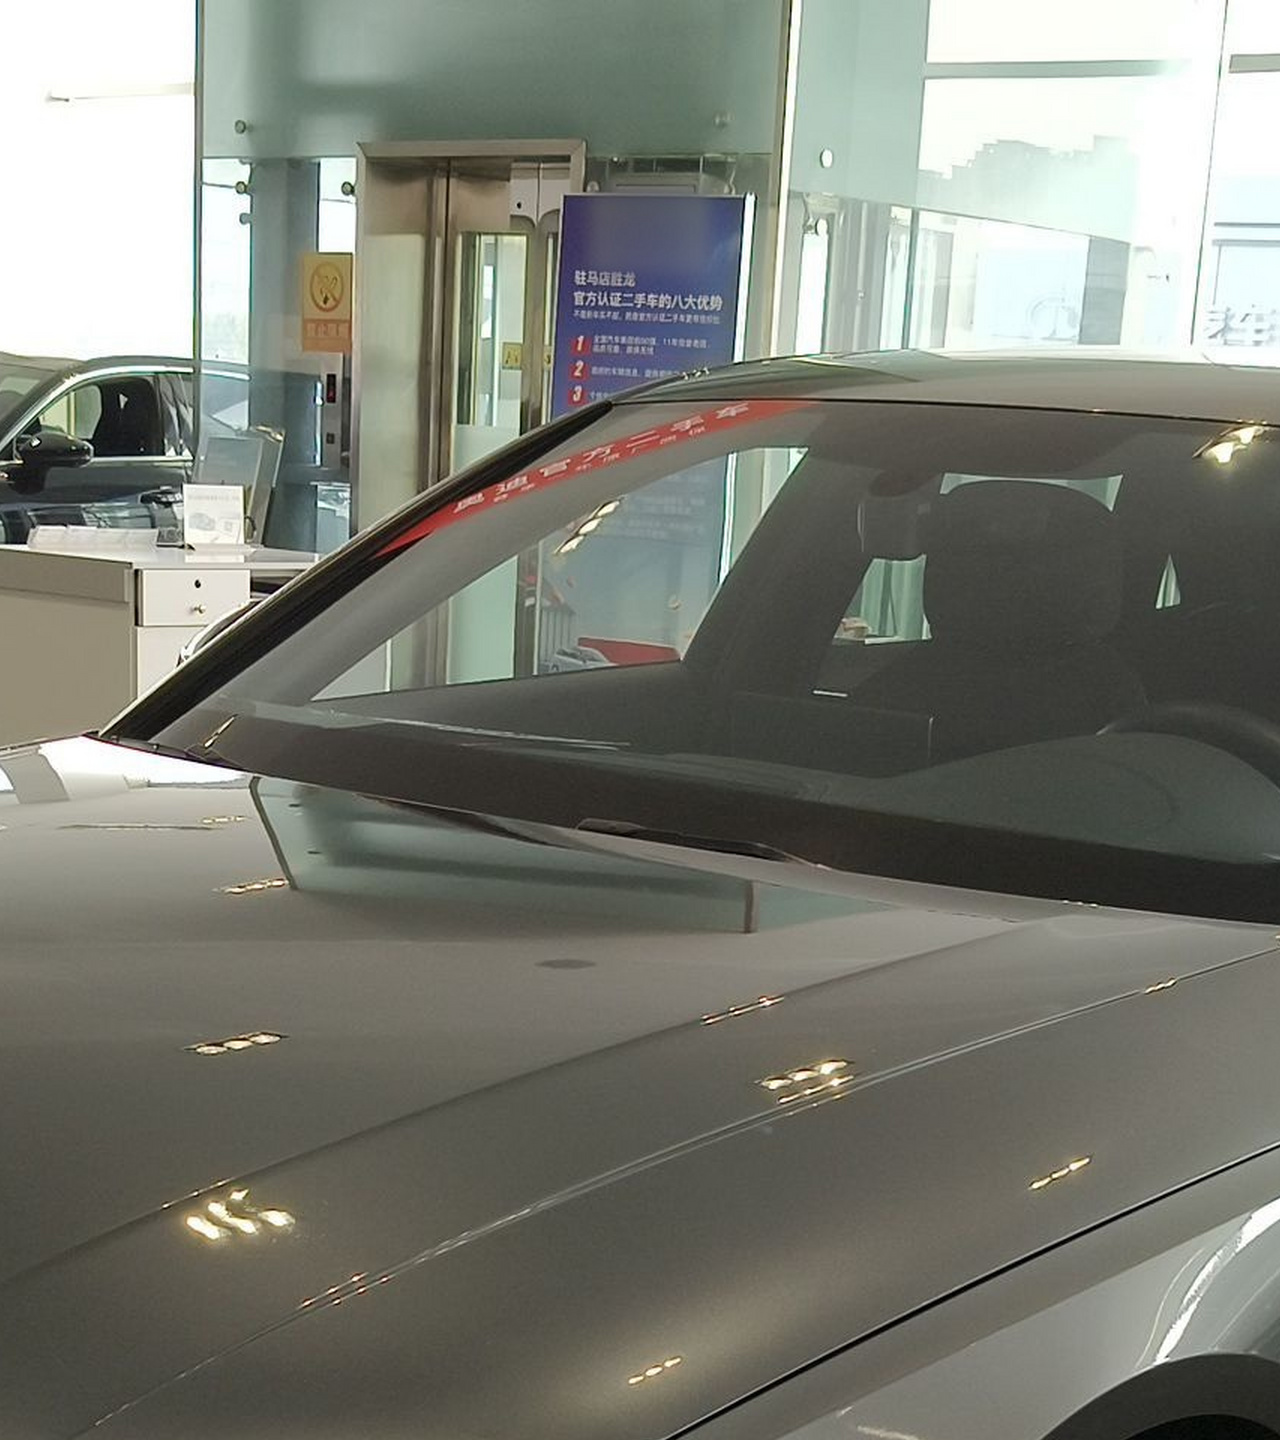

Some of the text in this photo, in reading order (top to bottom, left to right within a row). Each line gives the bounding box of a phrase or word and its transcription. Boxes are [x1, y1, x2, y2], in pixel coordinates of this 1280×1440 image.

[573, 291, 723, 312] 官方认证二手车的八大优势
[577, 335, 584, 351] 1
[574, 360, 584, 376] 2
[572, 385, 583, 402] 3
